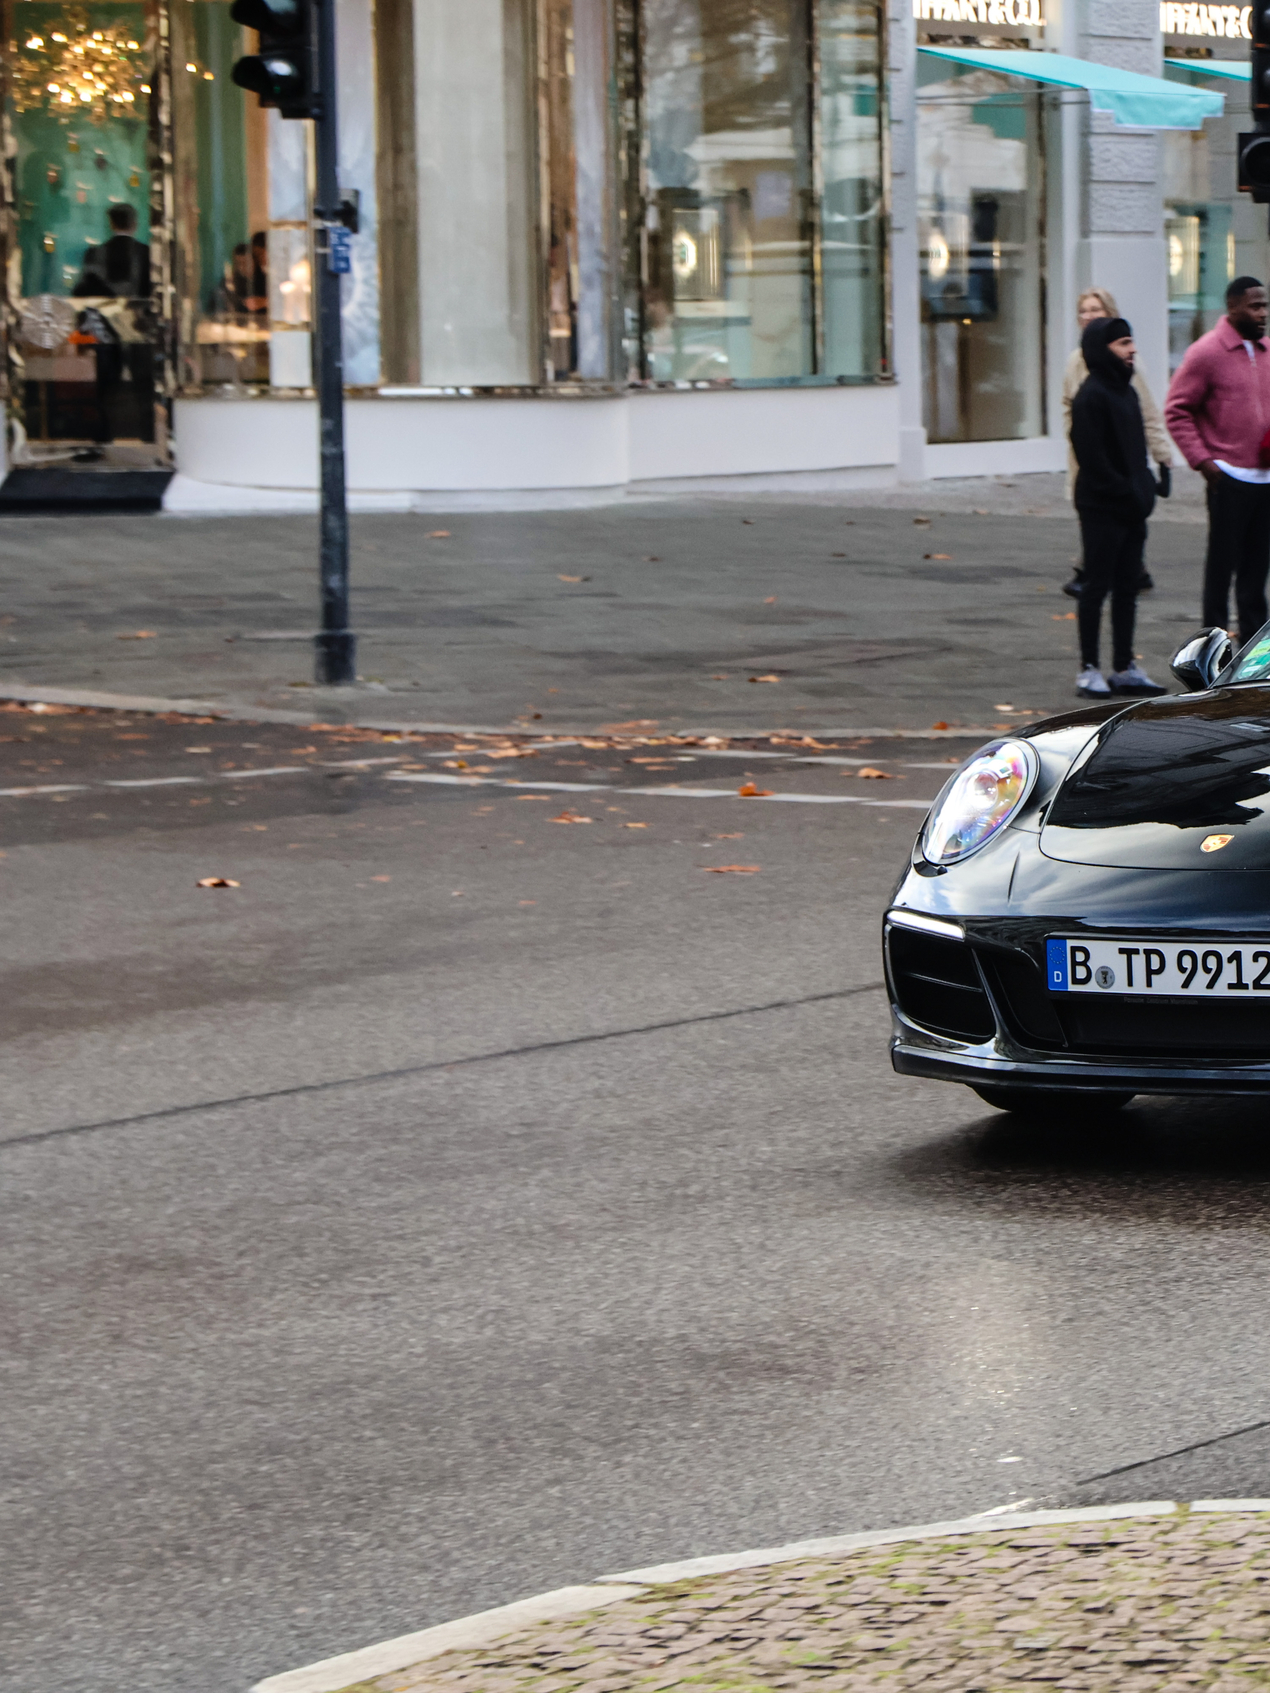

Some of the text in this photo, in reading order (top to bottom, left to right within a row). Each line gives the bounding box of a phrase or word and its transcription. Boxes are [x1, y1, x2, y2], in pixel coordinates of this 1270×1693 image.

[1054, 971, 1062, 982] D
[1070, 945, 1092, 986] B
[1118, 947, 1166, 988] TP
